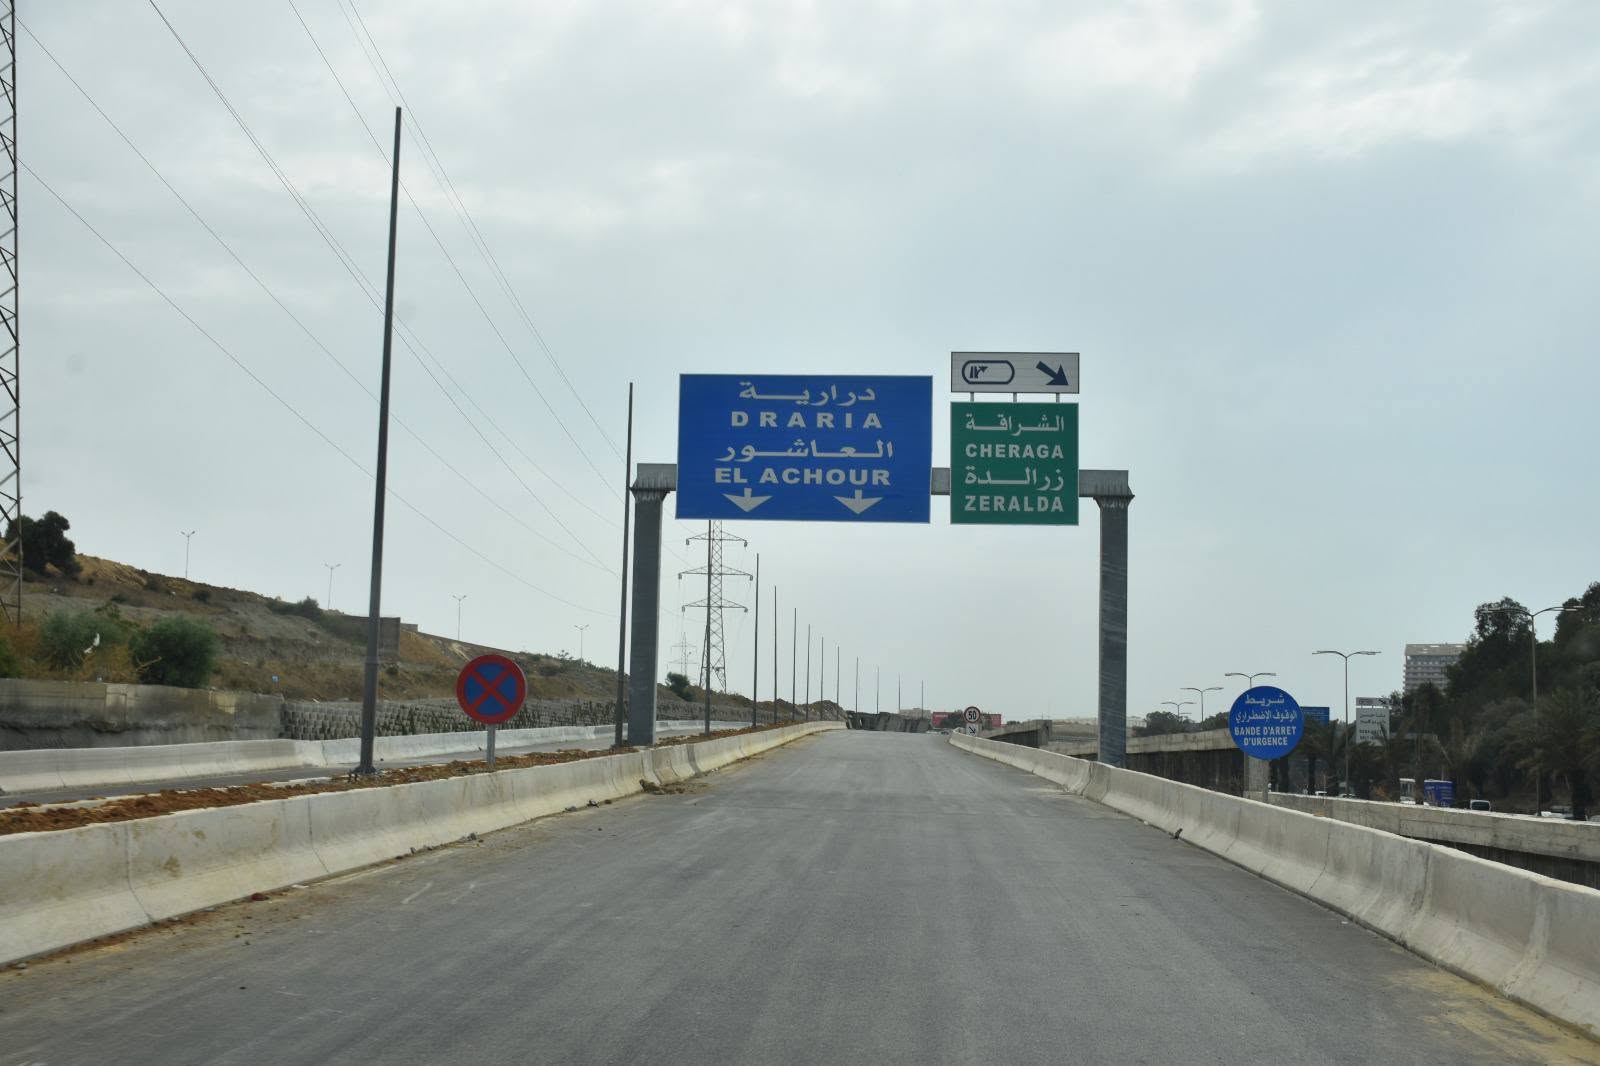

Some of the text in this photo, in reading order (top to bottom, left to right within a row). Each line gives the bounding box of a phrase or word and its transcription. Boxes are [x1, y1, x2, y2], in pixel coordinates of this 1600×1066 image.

[739, 380, 876, 407] درارية
[731, 411, 882, 429] DRARIA
[965, 413, 1065, 436] الشراقة
[714, 438, 894, 463] العاشور
[965, 443, 1064, 459] CHERAGA
[714, 467, 891, 486] EL ACHOUR
[964, 465, 1064, 491] زرالدة
[964, 495, 1064, 513] ZERALDA
[1245, 694, 1285, 707] شريط
[968, 710, 977, 720] 50
[1272, 709, 1298, 723] الوقوف
[1234, 726, 1297, 735] BANDE D'ARRET
[1243, 736, 1288, 746] D'URGENCE
